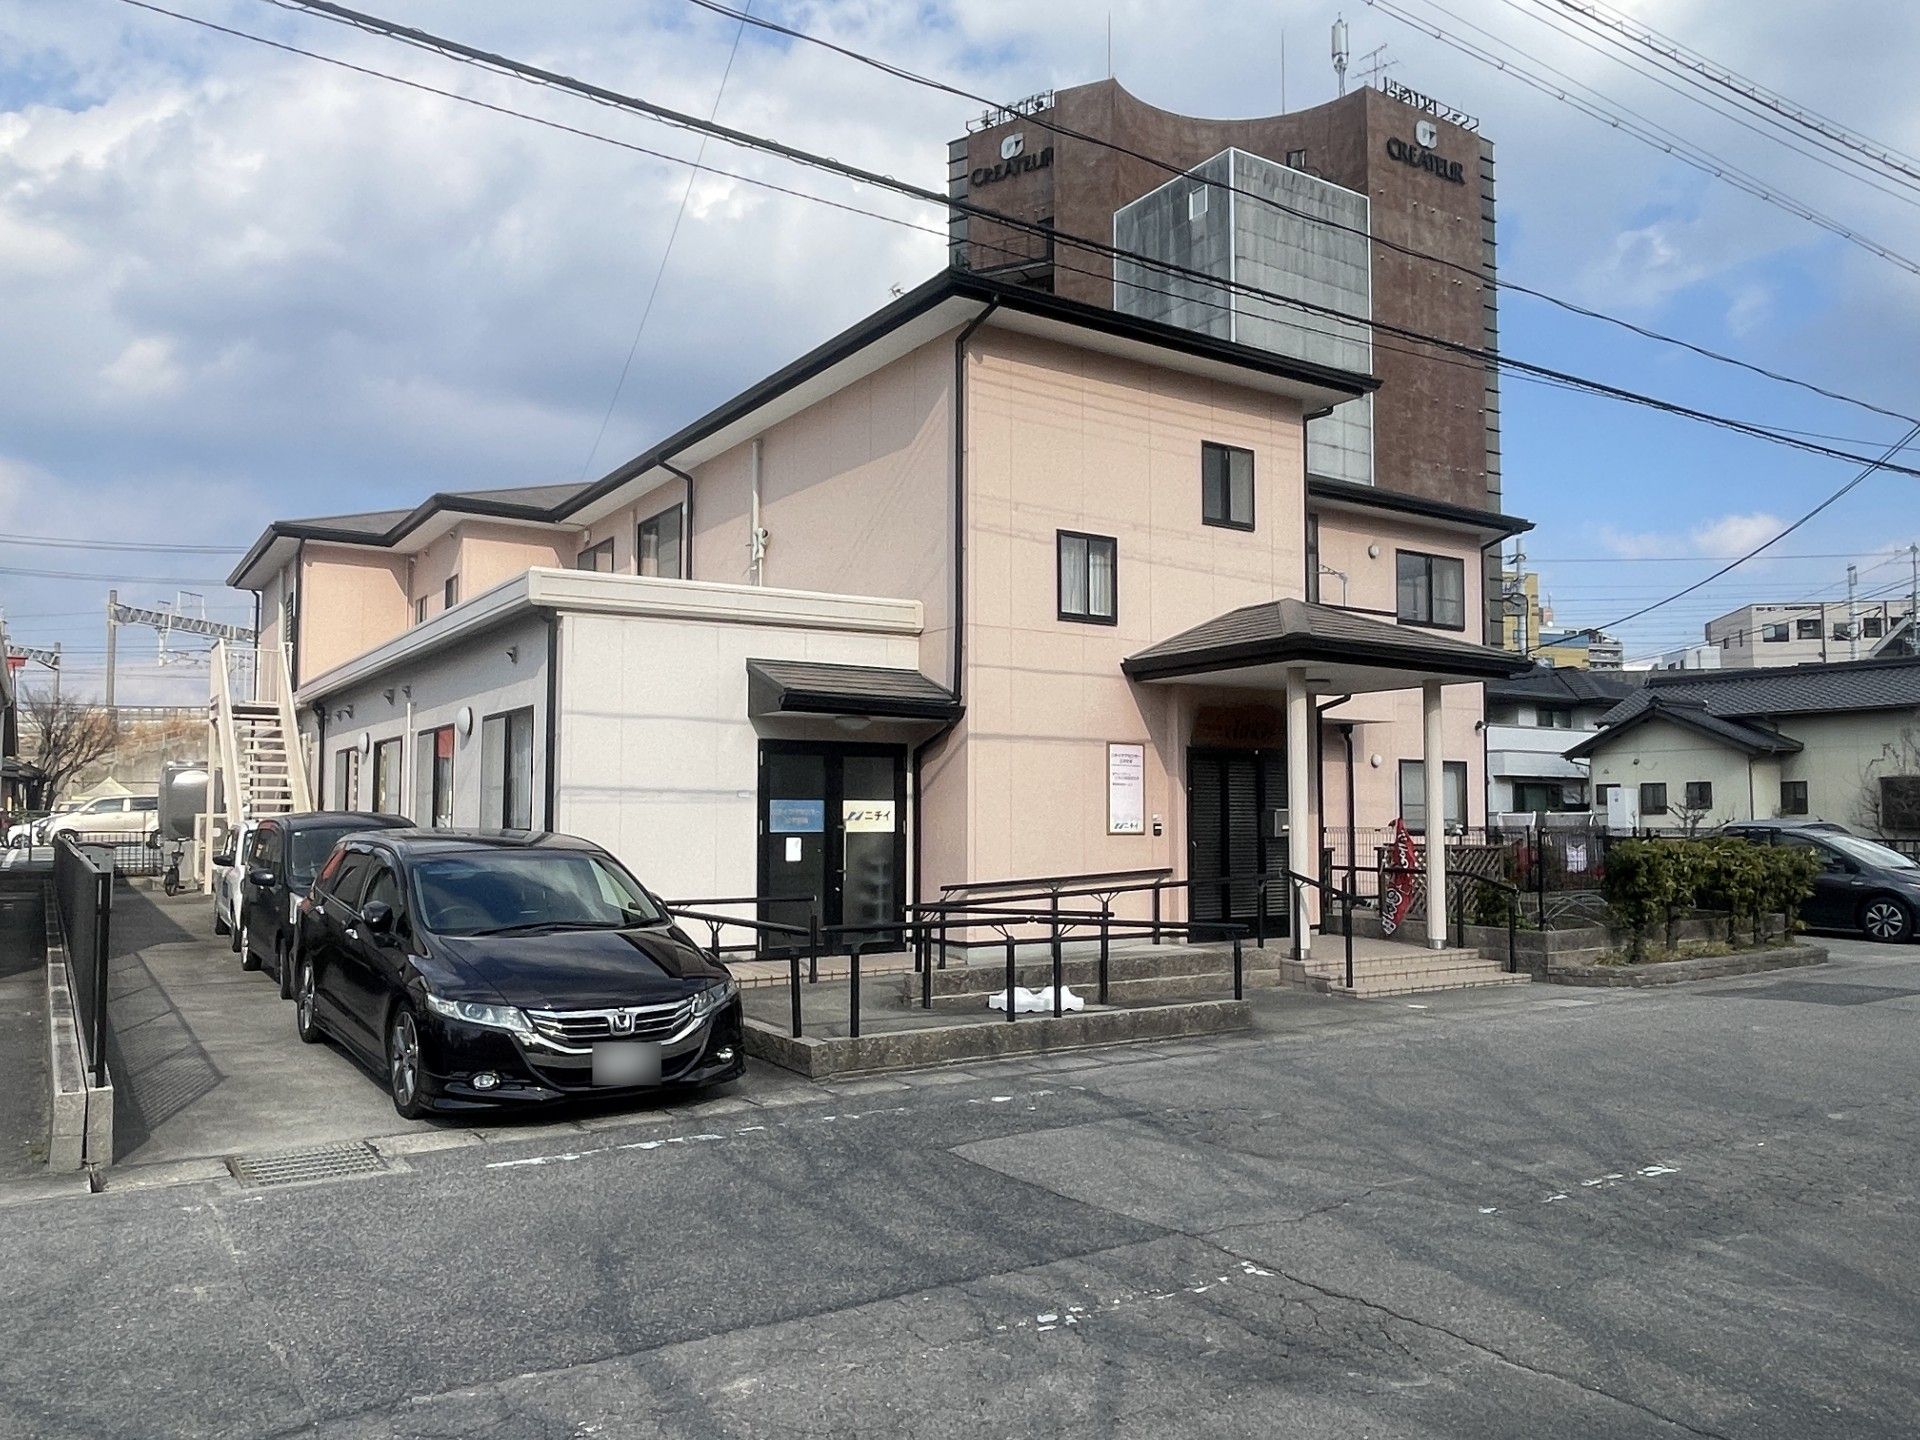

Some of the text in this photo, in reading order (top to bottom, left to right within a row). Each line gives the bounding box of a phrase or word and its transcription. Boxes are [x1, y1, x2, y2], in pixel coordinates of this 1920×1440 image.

[1386, 137, 1466, 185] CREATEUR
[865, 810, 891, 821] ニチイ
